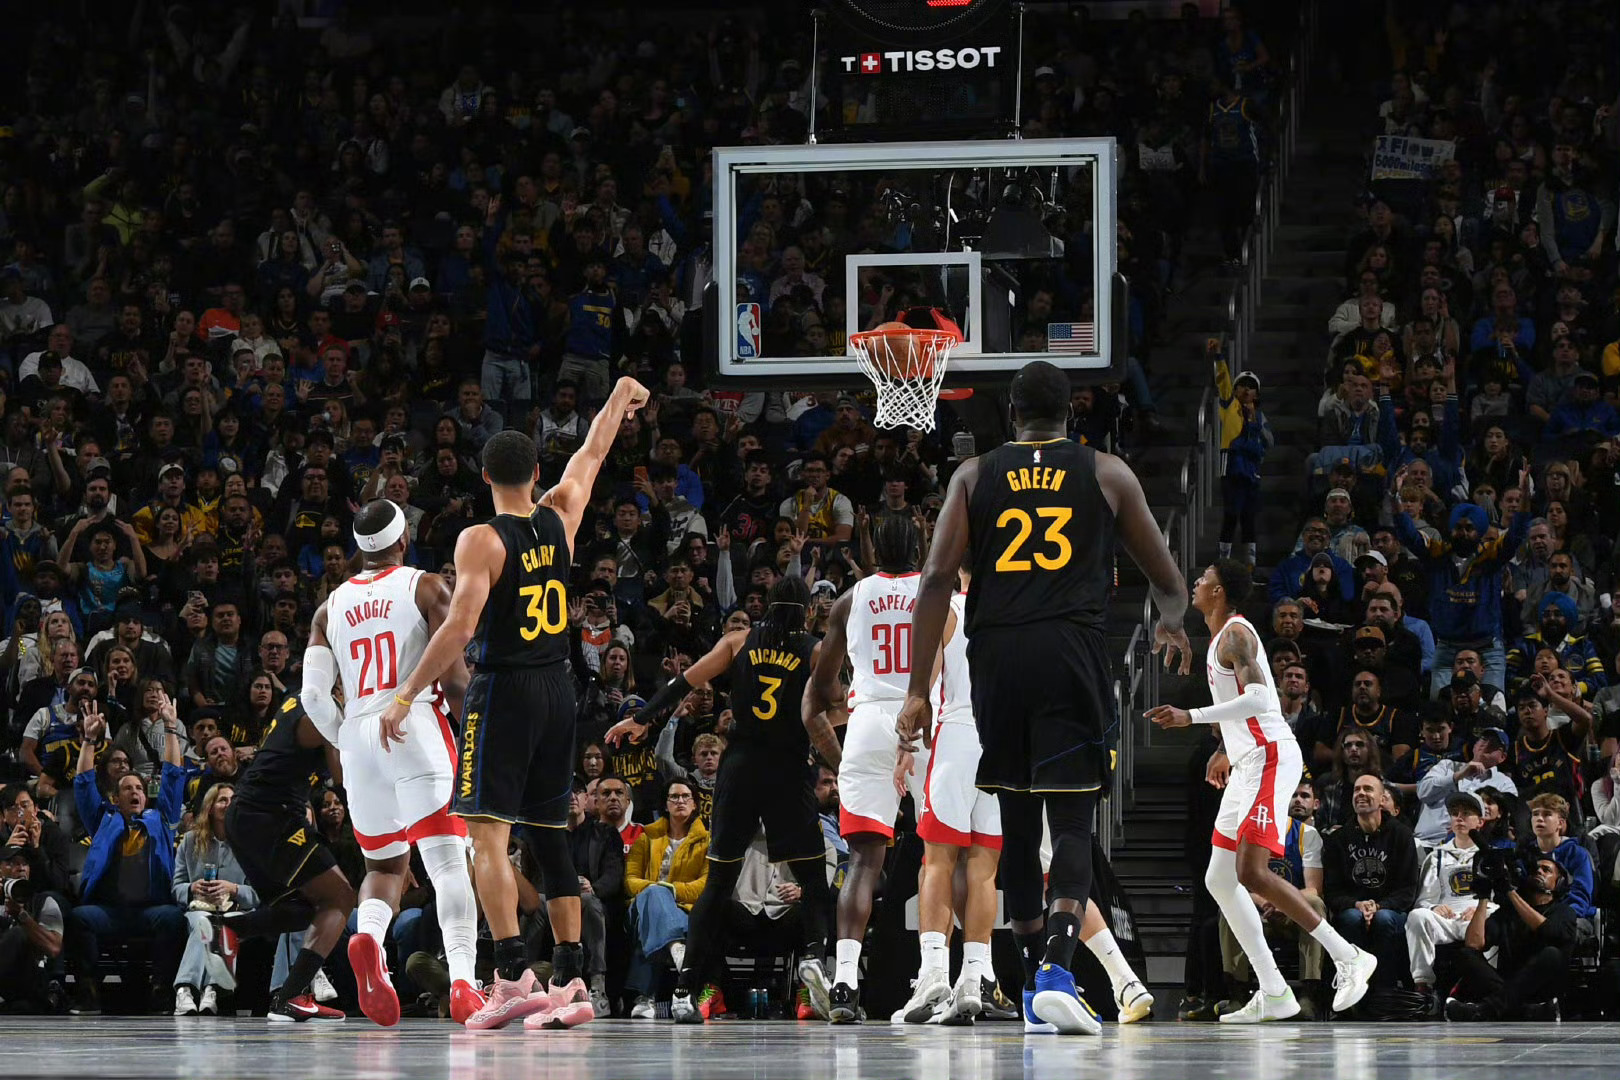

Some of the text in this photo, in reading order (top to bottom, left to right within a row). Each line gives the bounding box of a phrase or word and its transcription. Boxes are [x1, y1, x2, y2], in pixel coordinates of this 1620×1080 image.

[884, 46, 1001, 73] TISSOT
[739, 345, 752, 355] NBA
[1006, 466, 1067, 492] GREEN
[995, 506, 1073, 573] 23
[521, 544, 556, 573] CURY
[345, 599, 393, 628] OKOGIE
[518, 579, 568, 641] 30
[868, 594, 916, 615] CAPELA
[748, 642, 801, 672] RICHARD
[871, 623, 913, 675] 30
[350, 630, 398, 699] 20
[752, 674, 783, 720] 3
[460, 711, 480, 798] WARRIORS
[1349, 847, 1388, 862] TOWN
